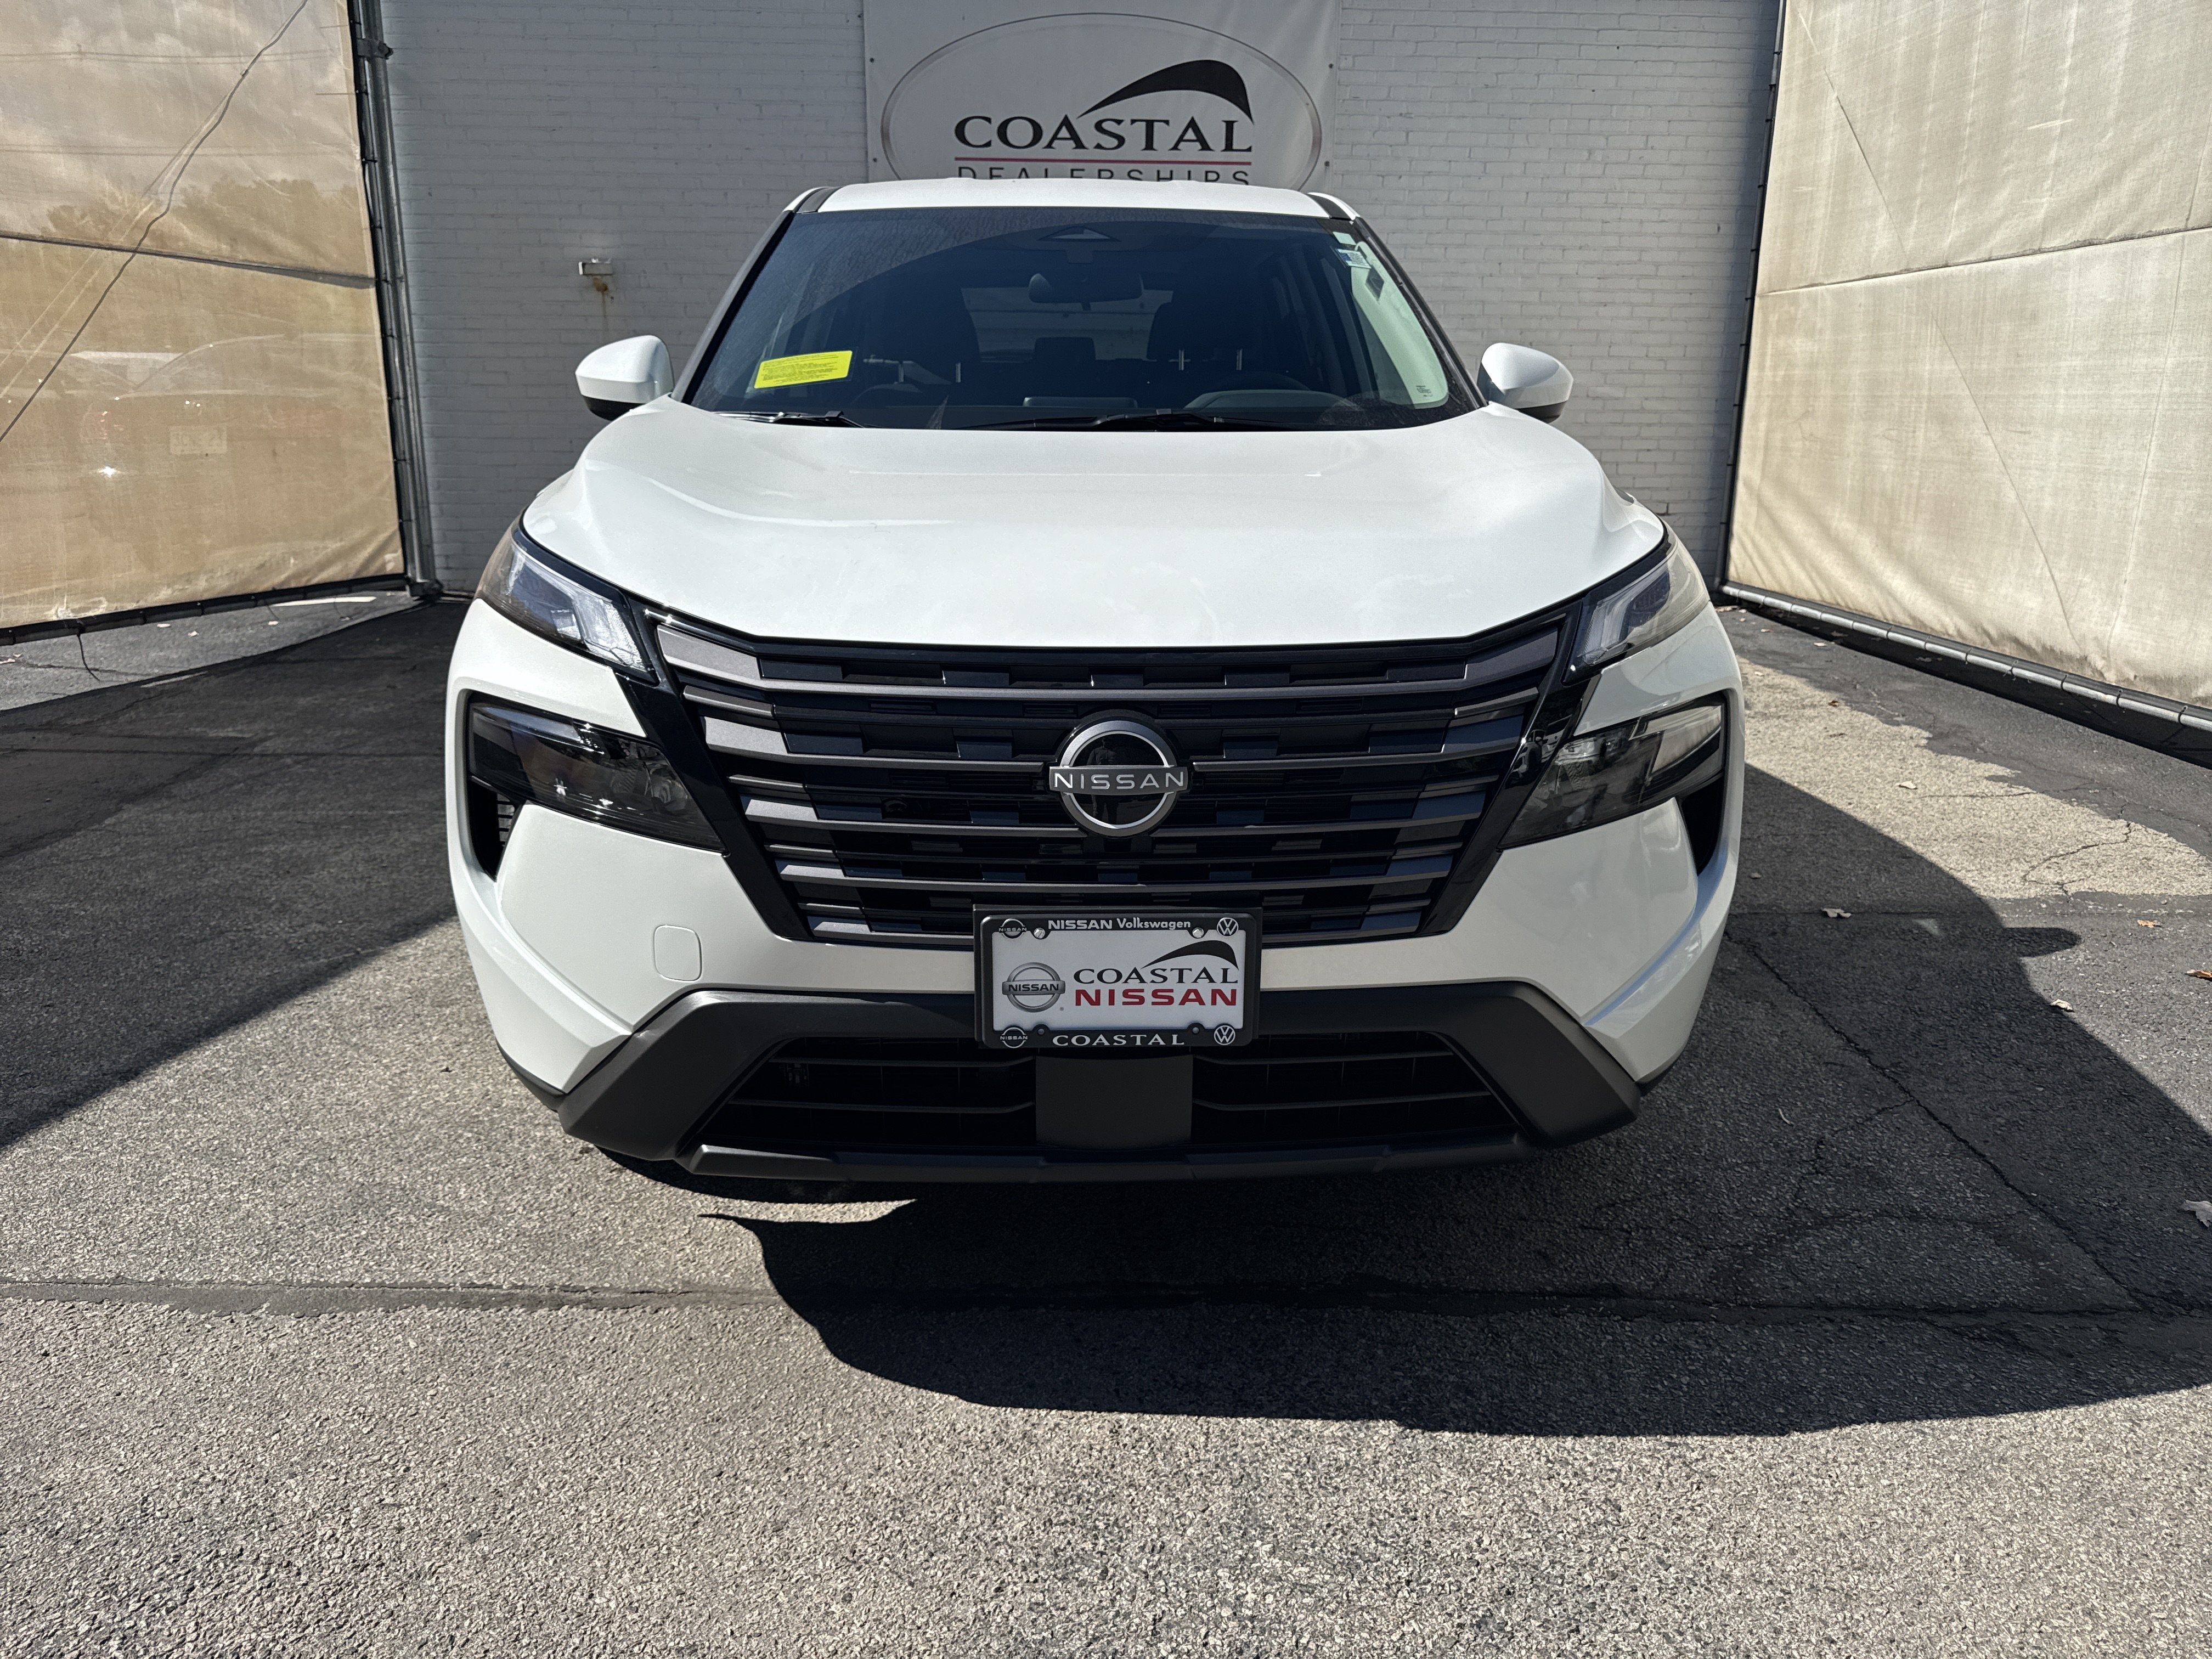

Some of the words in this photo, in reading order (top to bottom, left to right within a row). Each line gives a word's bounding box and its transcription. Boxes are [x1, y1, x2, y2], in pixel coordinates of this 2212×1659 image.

[955, 114, 1252, 153] COASTAL
[1054, 771, 1184, 789] NISSAN
[1048, 919, 1113, 929] NISSAN
[1116, 917, 1191, 930] Volkswagen
[1073, 967, 1238, 984] COASTAL
[1008, 983, 1059, 992] NISSAN
[1075, 989, 1237, 1006] NISSAN
[1052, 1034, 1184, 1046] COASTAL
